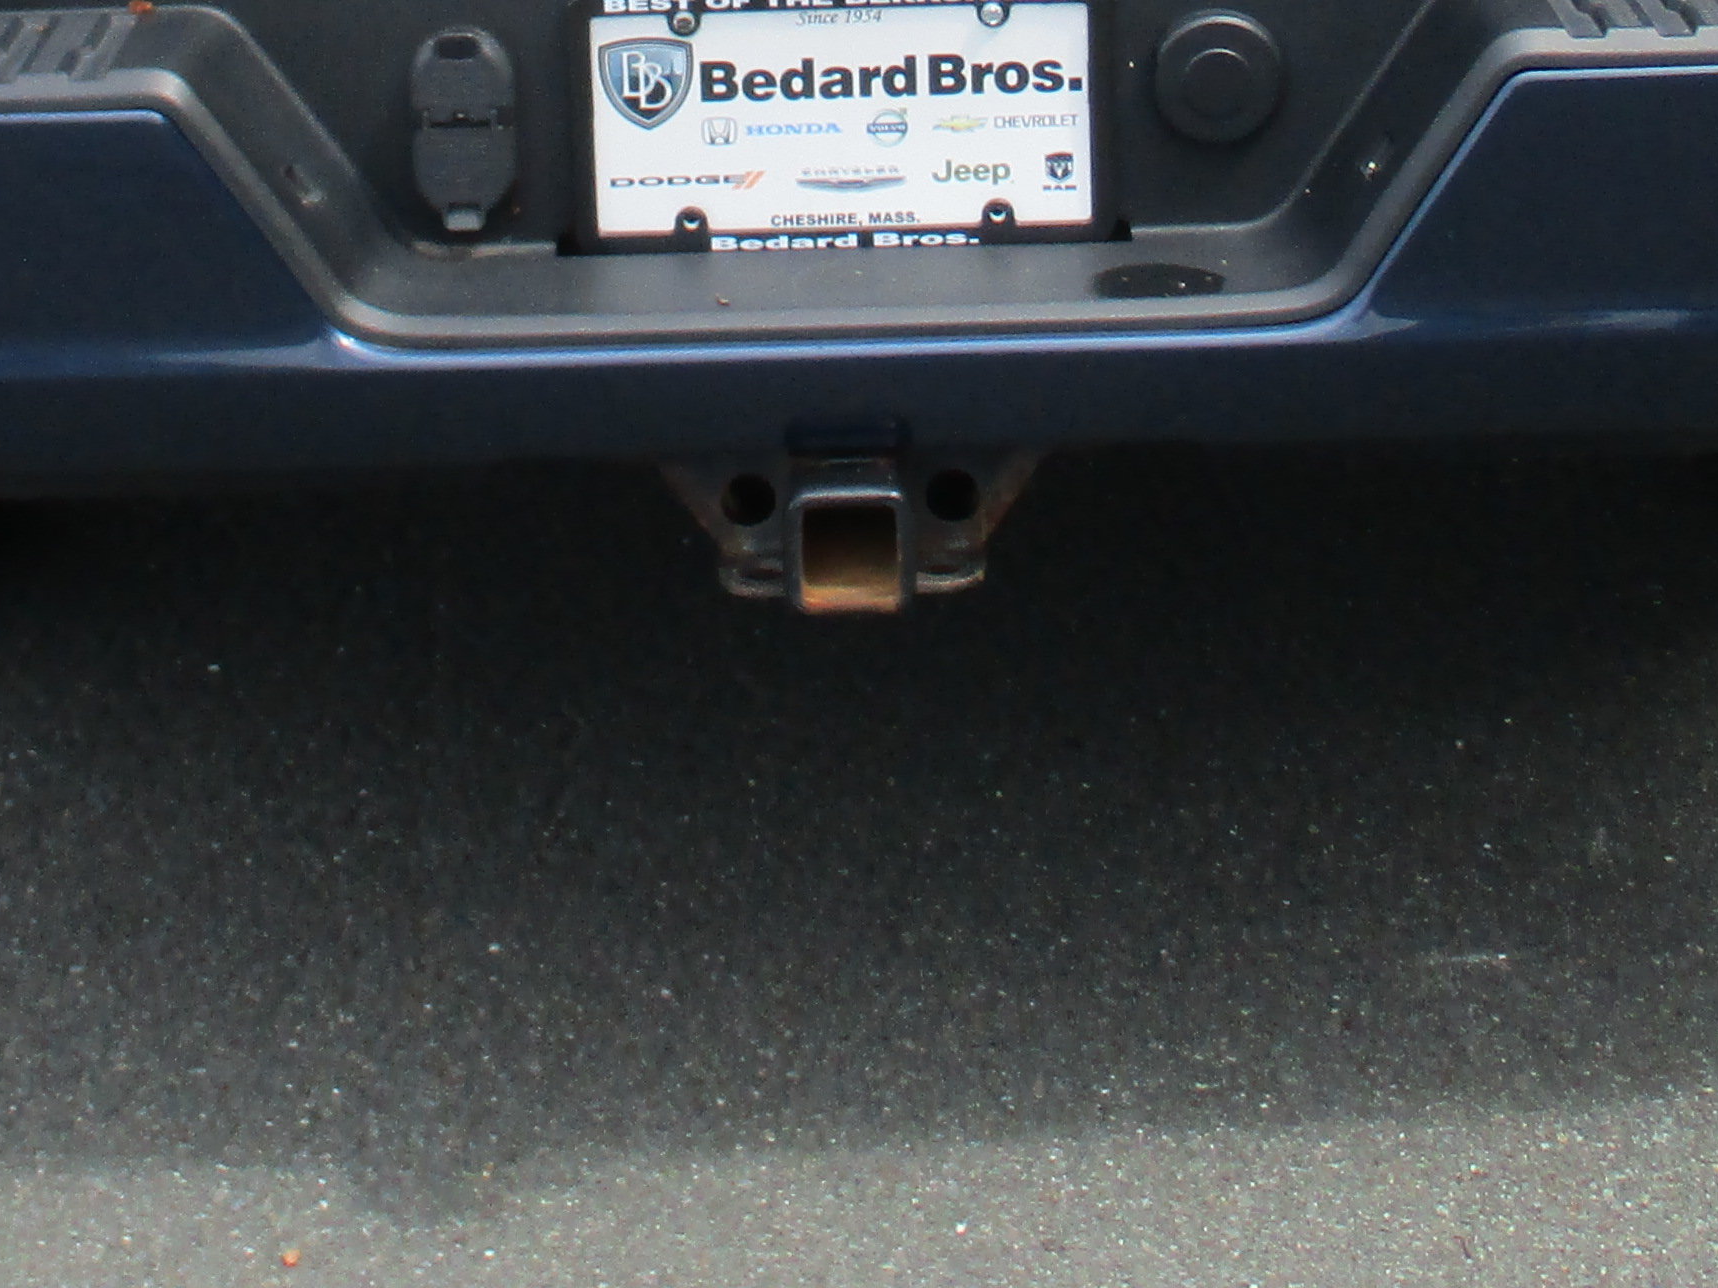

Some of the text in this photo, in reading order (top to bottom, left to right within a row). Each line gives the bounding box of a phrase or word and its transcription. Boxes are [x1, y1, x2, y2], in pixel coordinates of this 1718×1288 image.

[795, 12, 839, 26] Since
[700, 53, 1083, 103] Bedard Bros.
[994, 114, 1079, 129] CHEVROLET
[744, 122, 843, 137] HONDA
[933, 159, 1012, 185] Jeep
[610, 174, 746, 188] DODGE
[771, 212, 921, 226] CHESHIRE, MASS.
[710, 231, 980, 251] Bedard Bros.
